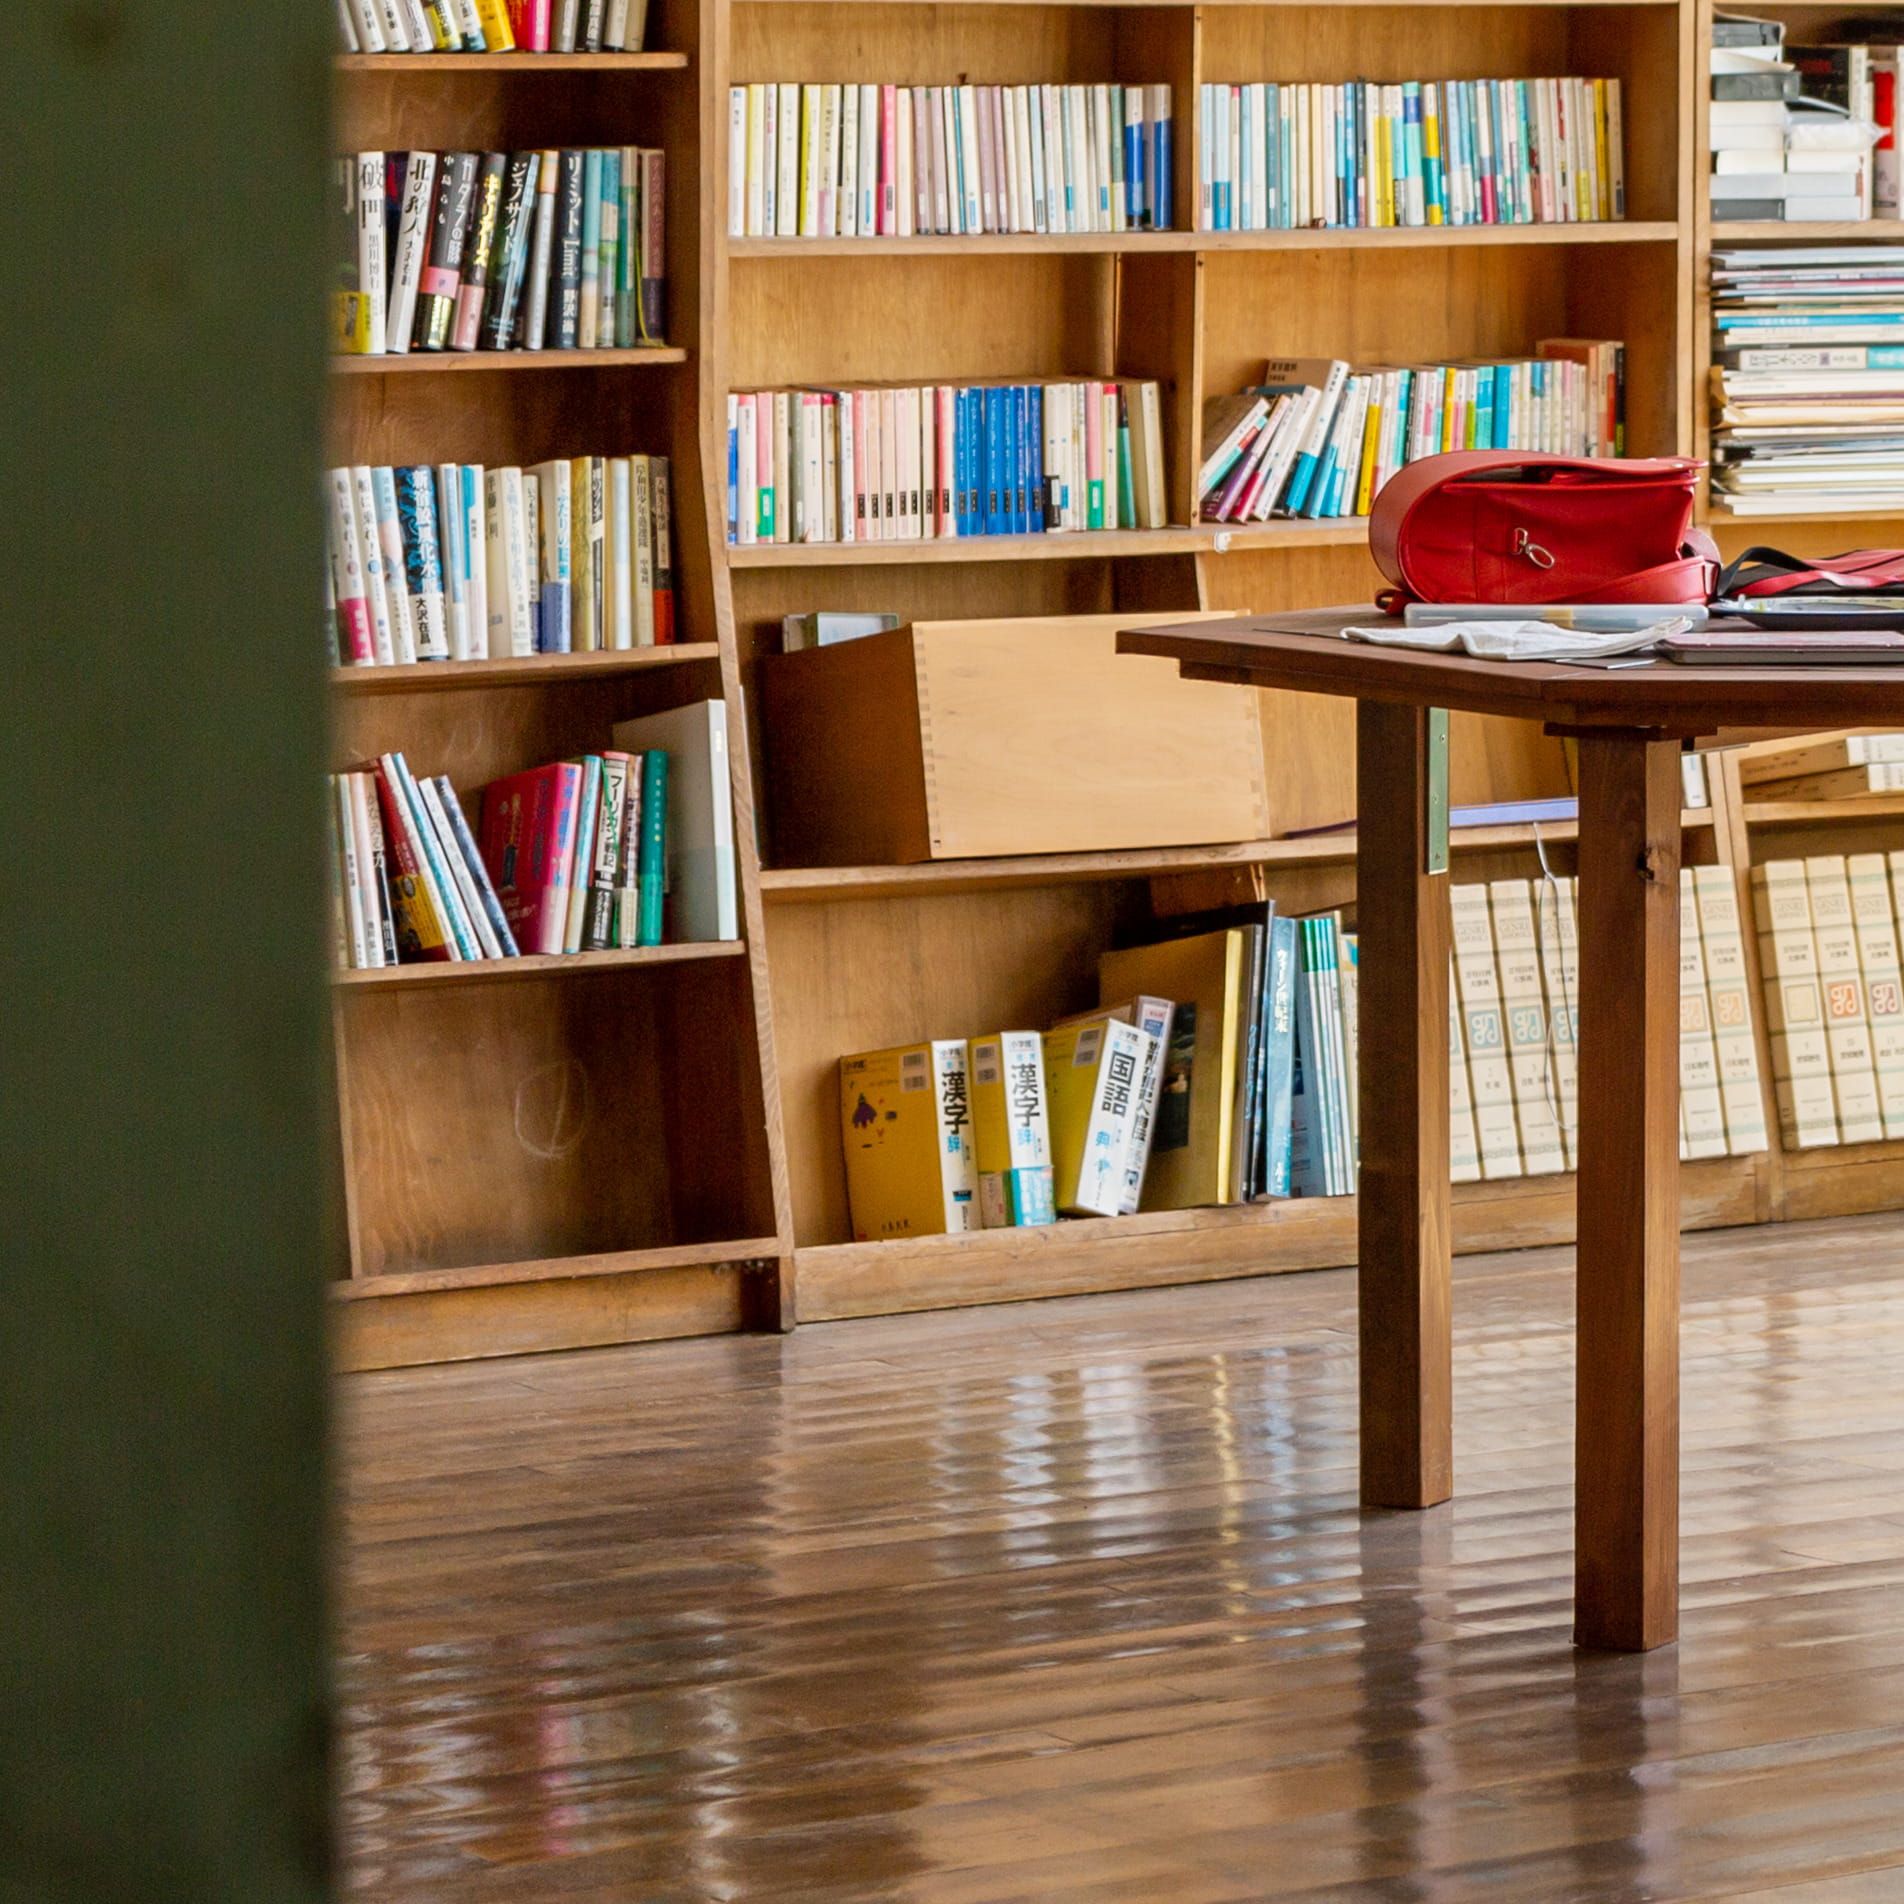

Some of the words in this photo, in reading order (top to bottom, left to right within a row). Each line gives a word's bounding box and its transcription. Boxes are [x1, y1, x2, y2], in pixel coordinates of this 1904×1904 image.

[360, 162, 385, 229] 破門
[405, 158, 433, 236] 北の狩人
[502, 160, 529, 254] ジェノサイド
[565, 155, 582, 234] リミット
[415, 598, 431, 645] 大沢在昌
